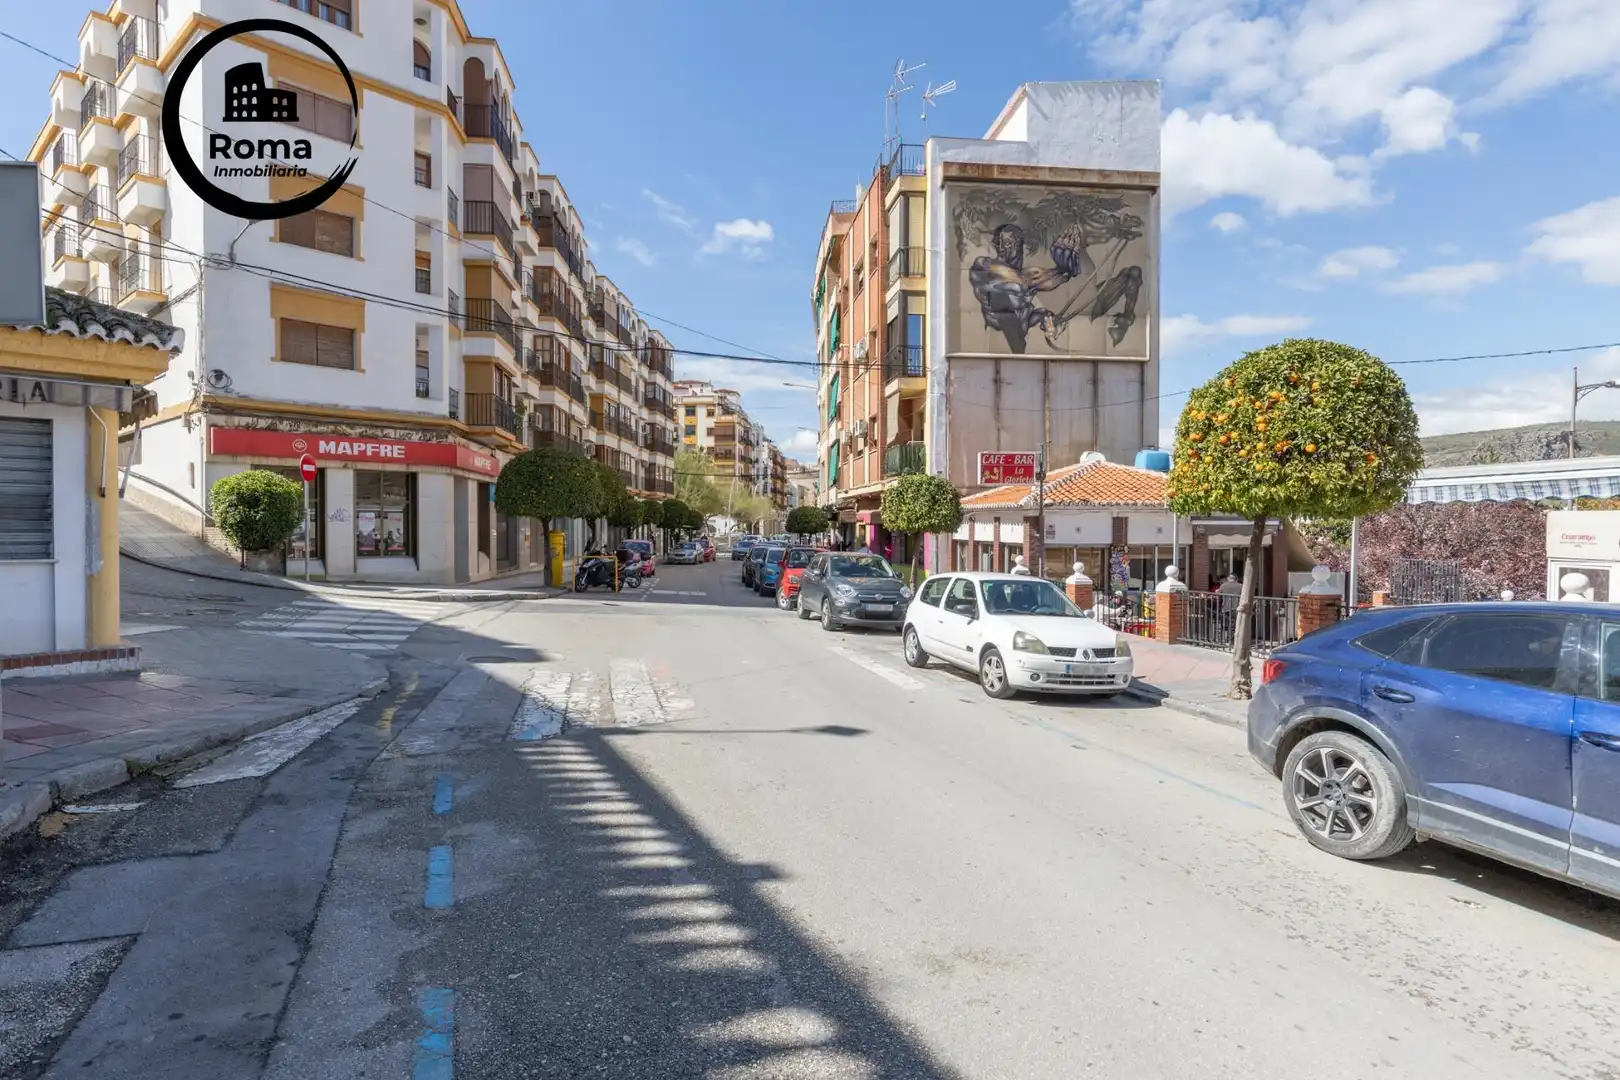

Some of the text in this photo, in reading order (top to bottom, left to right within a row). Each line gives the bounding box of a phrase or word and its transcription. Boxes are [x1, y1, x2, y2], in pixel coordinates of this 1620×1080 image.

[0, 378, 47, 402] IA
[318, 440, 406, 458] MAPFRE
[1014, 454, 1034, 464] BAR
[1015, 467, 1024, 475] La
